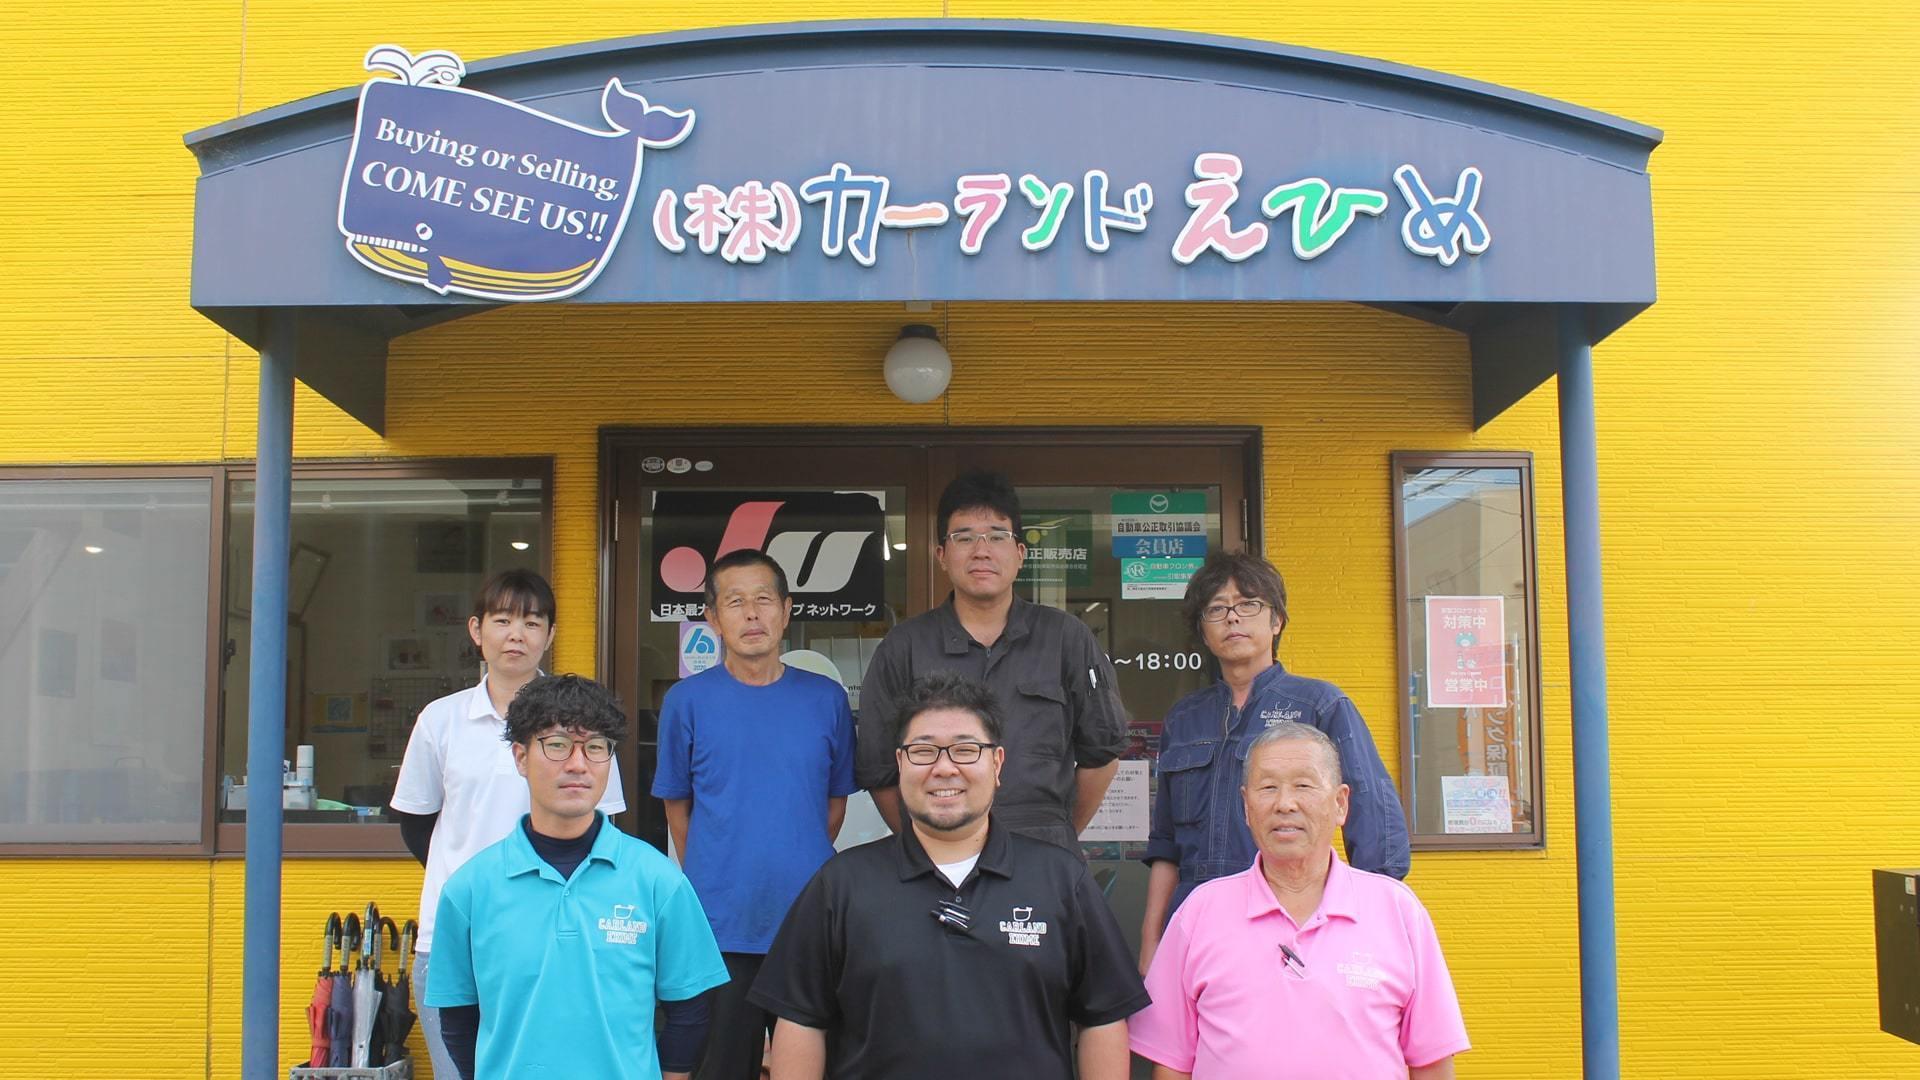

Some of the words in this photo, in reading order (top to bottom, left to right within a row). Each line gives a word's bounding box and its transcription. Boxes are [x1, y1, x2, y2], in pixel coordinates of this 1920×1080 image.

[375, 118, 479, 167] Buying
[482, 149, 515, 171] or
[518, 153, 619, 201] Selling,
[362, 161, 466, 207] COME
[470, 187, 535, 223] SEE
[540, 202, 610, 242] US!!
[1117, 521, 1201, 532] 自動車公正取引協議会
[1136, 538, 1184, 555] 会員店
[1442, 614, 1486, 629] 対策中
[1445, 678, 1488, 692] 営業中
